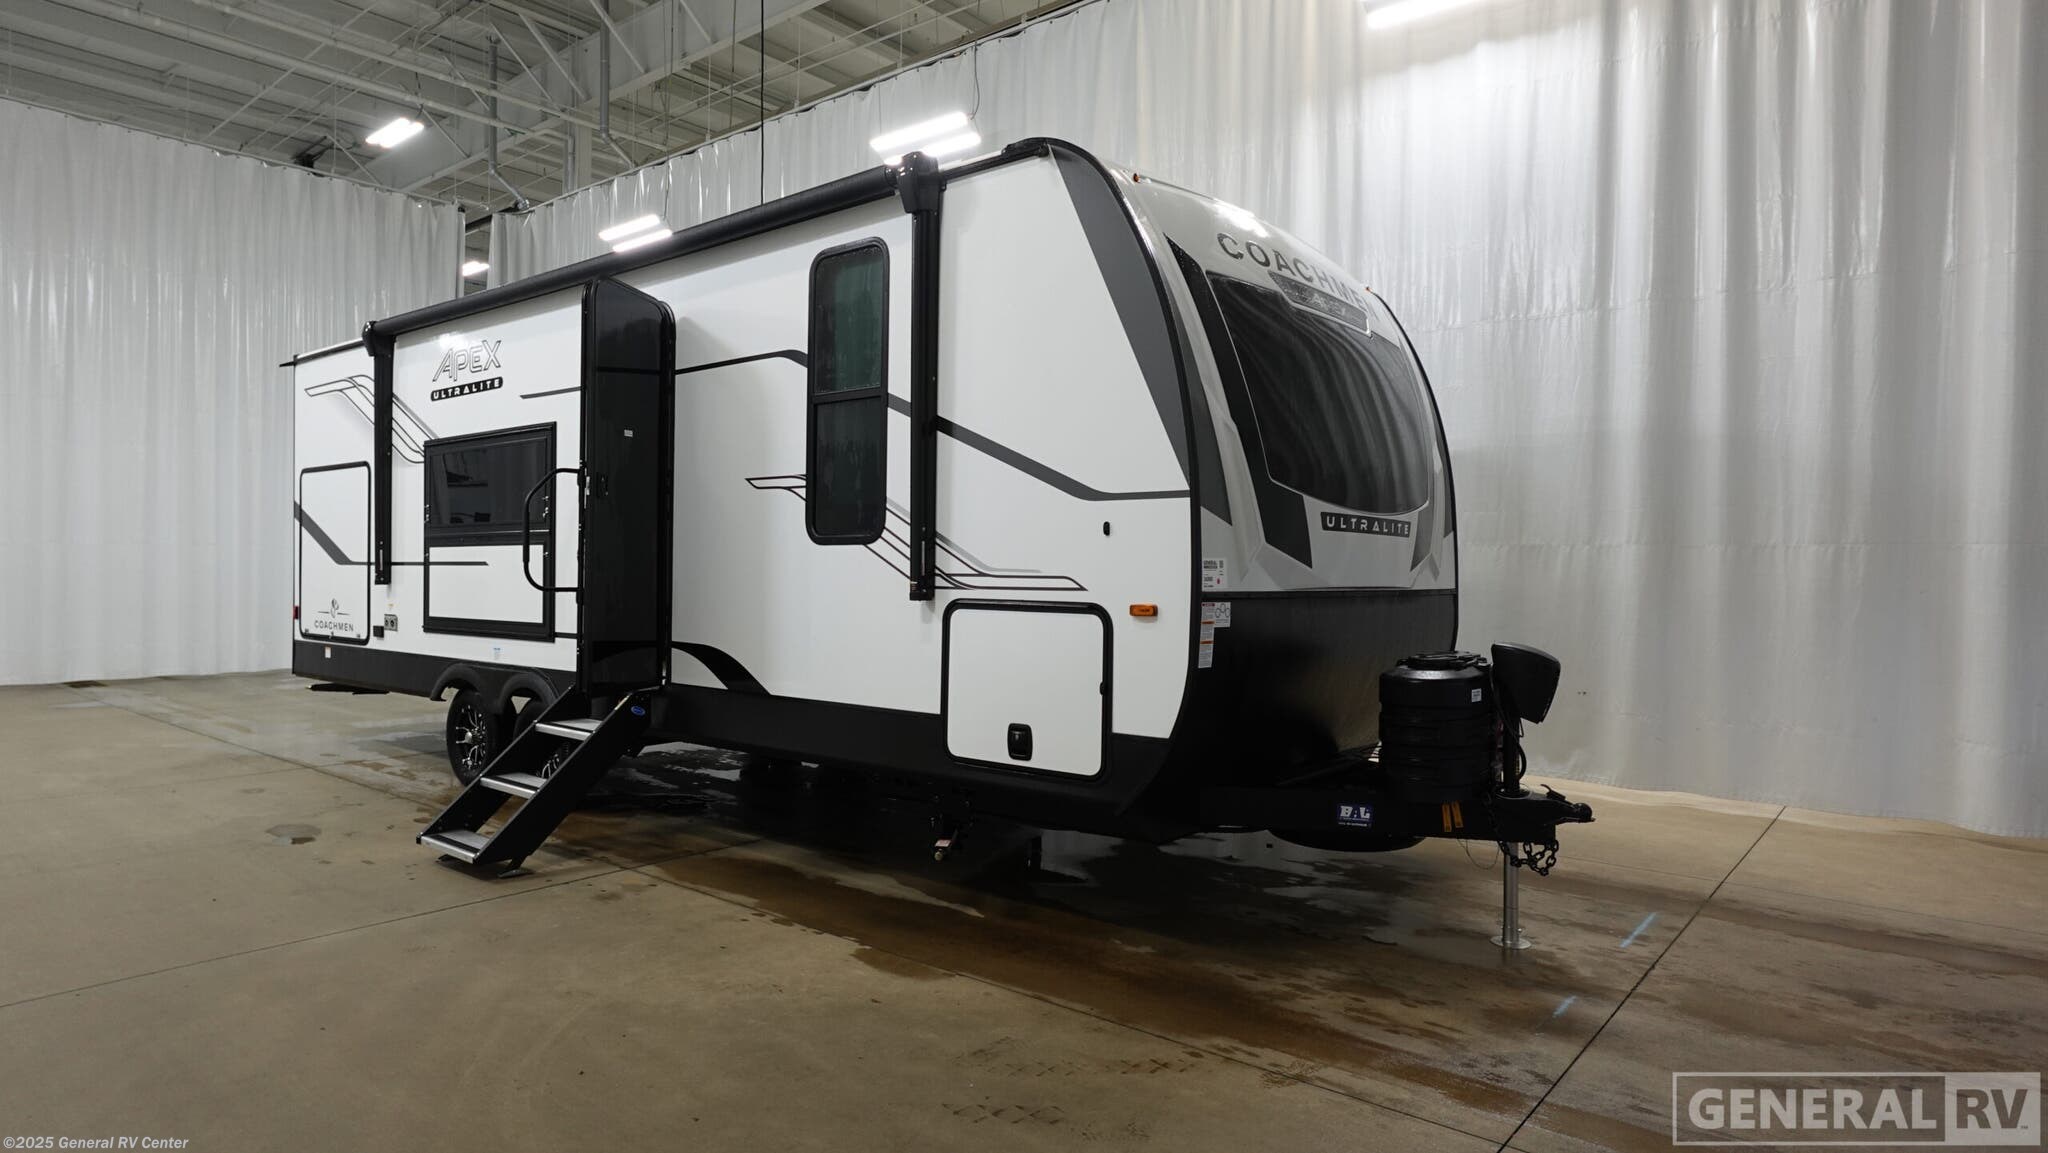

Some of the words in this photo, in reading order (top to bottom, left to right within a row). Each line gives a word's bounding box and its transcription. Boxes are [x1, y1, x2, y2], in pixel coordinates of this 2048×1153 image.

[1216, 232, 1380, 321] COACHMEN
[432, 340, 502, 382] APEX
[433, 379, 500, 400] ULTRALITE
[1326, 515, 1409, 535] ULTRALITE
[313, 620, 354, 632] COACHMEN
